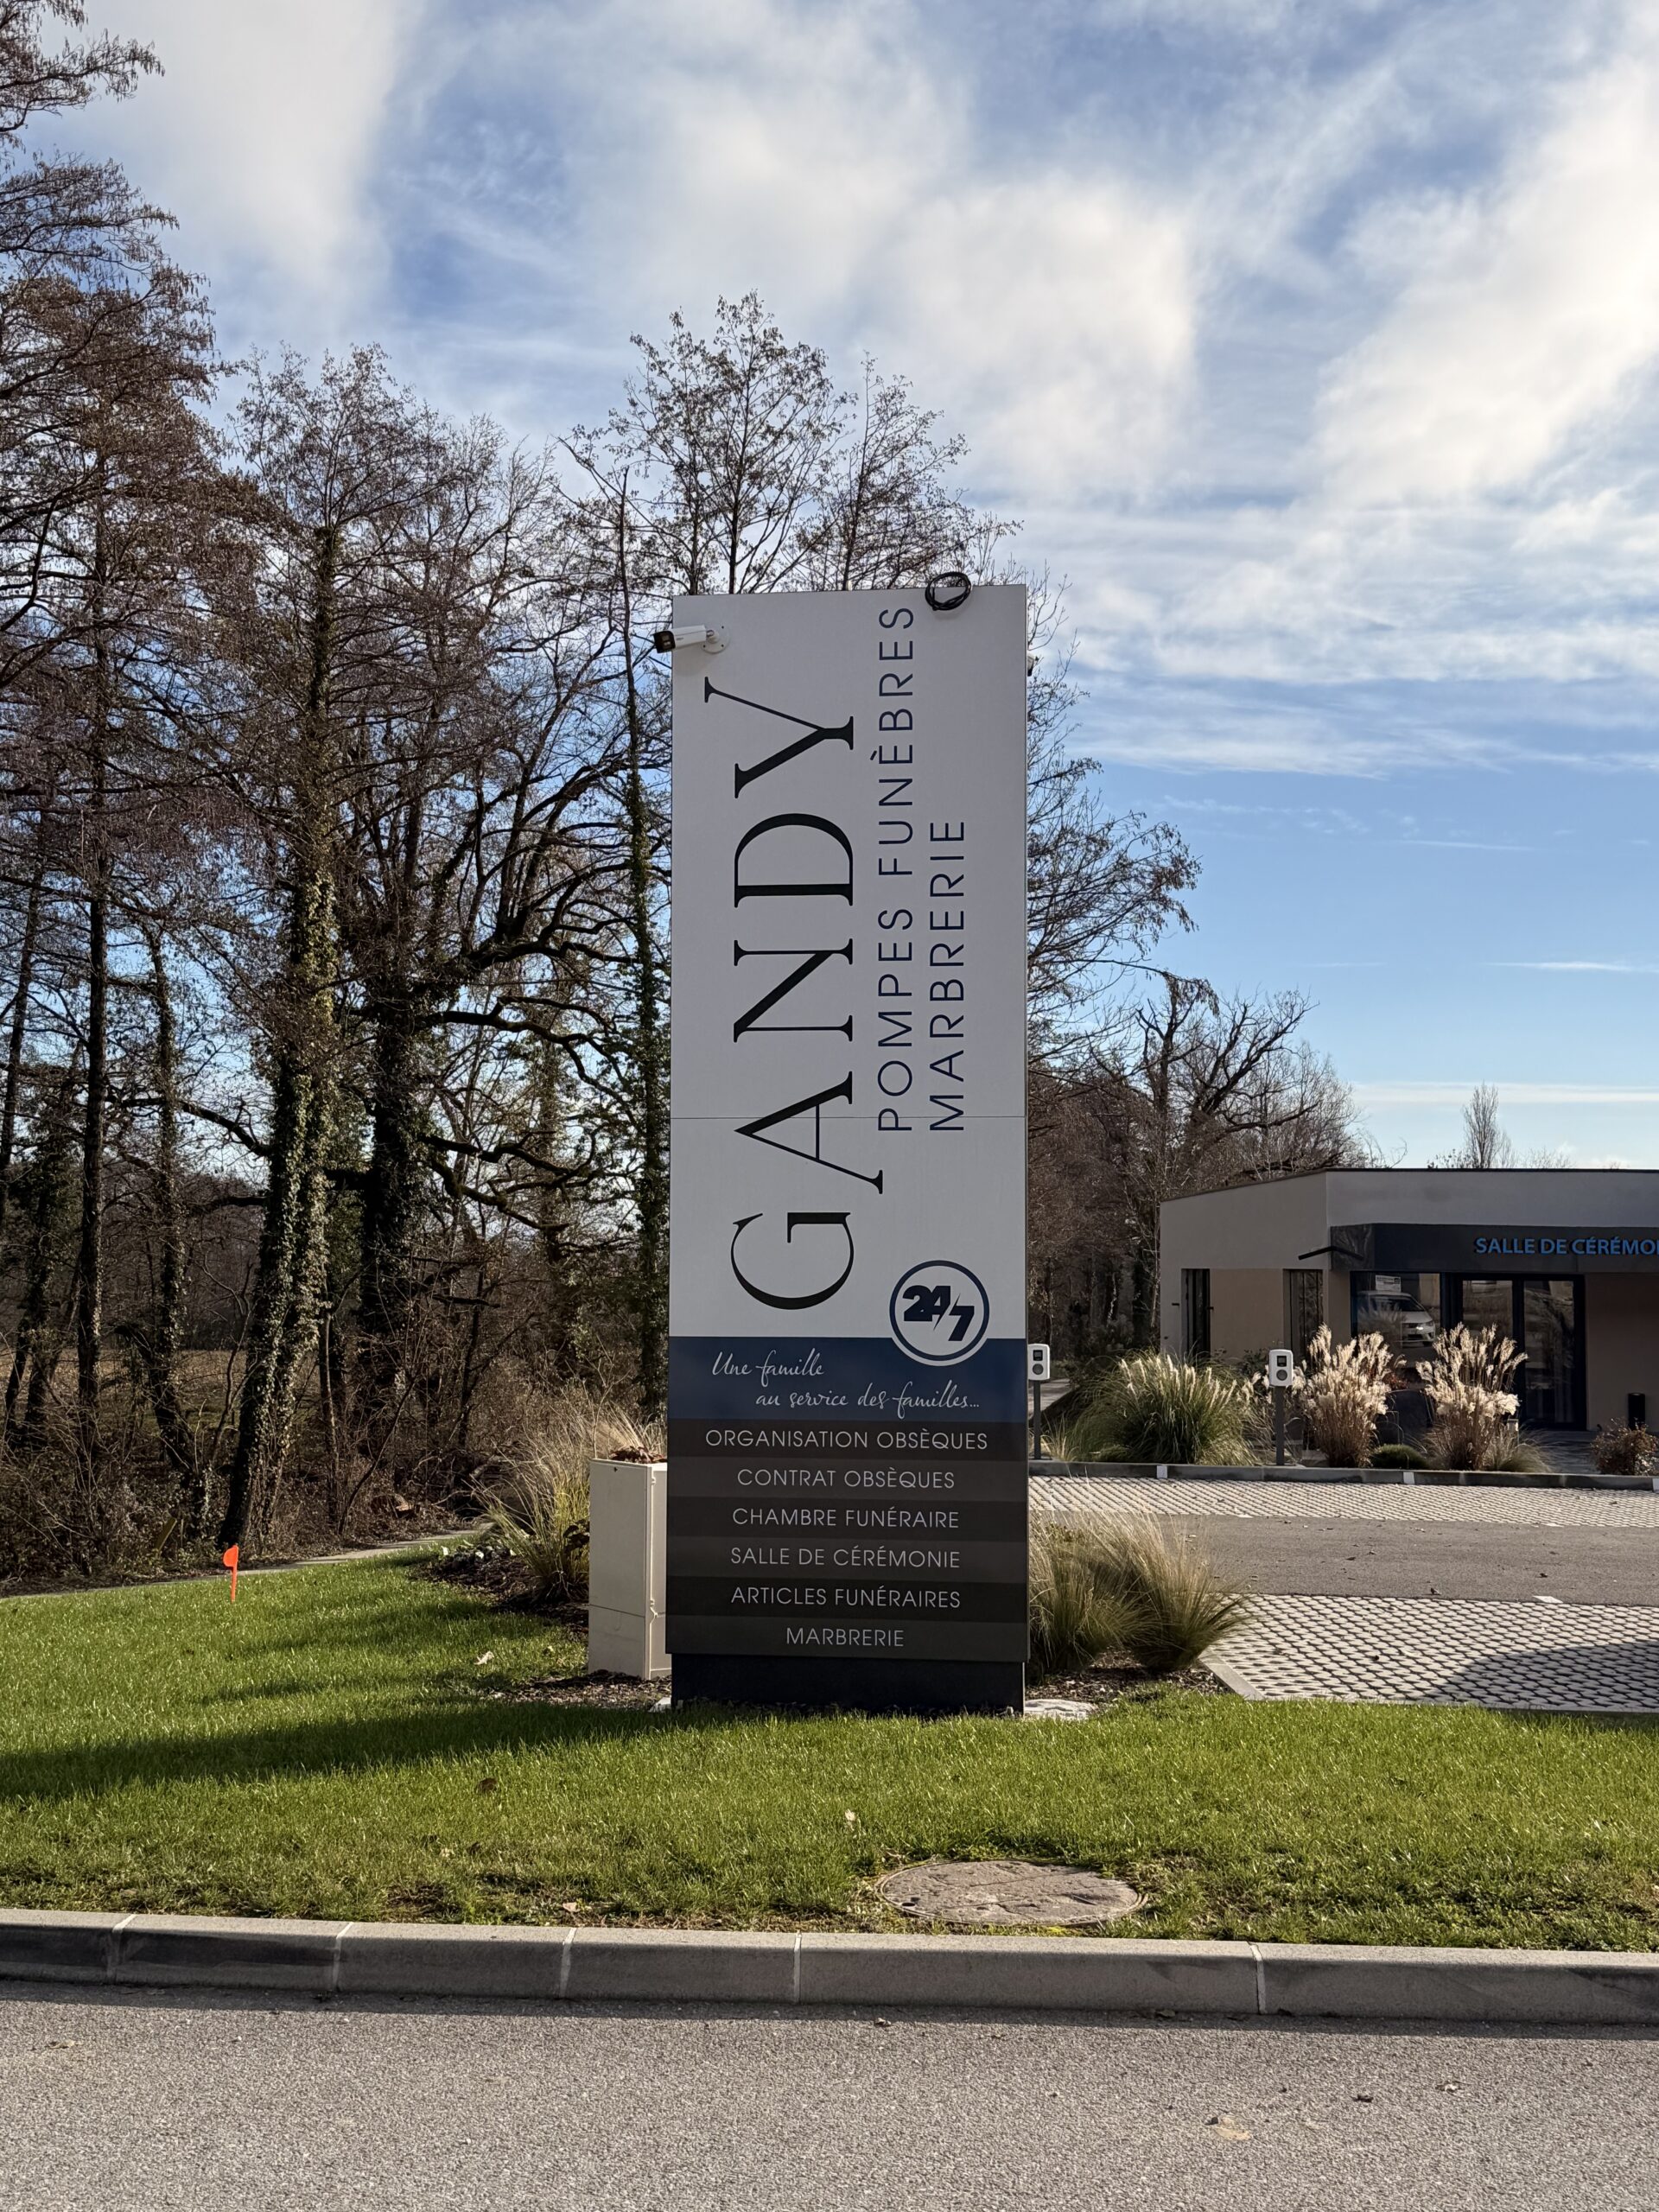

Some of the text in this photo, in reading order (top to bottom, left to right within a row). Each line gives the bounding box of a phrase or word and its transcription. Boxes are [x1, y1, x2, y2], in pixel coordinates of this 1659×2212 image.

[870, 607, 914, 1132] POMPES FUNÈBRES
[929, 821, 965, 1132] MARBRERIE
[704, 676, 884, 1311] GANDY
[1475, 1236, 1659, 1255] SALLE DE CÉRÉMO
[902, 1284, 975, 1342] 24/7
[711, 1347, 825, 1388] Une famille
[755, 1395, 781, 1407] au
[790, 1389, 849, 1408] service
[857, 1382, 890, 1410] des
[705, 1427, 988, 1450] ORGANISATION OBSÈQUES
[737, 1466, 955, 1489] CONTRAT OBSÈQUES
[732, 1506, 959, 1529] CHAMBRE FUNÉRAIRE
[730, 1544, 960, 1568] SALLE DE CÉRÉMONIE
[730, 1585, 961, 1609] ARTICLES FUNÉRAIRES
[786, 1627, 904, 1647] MARBRERIE
